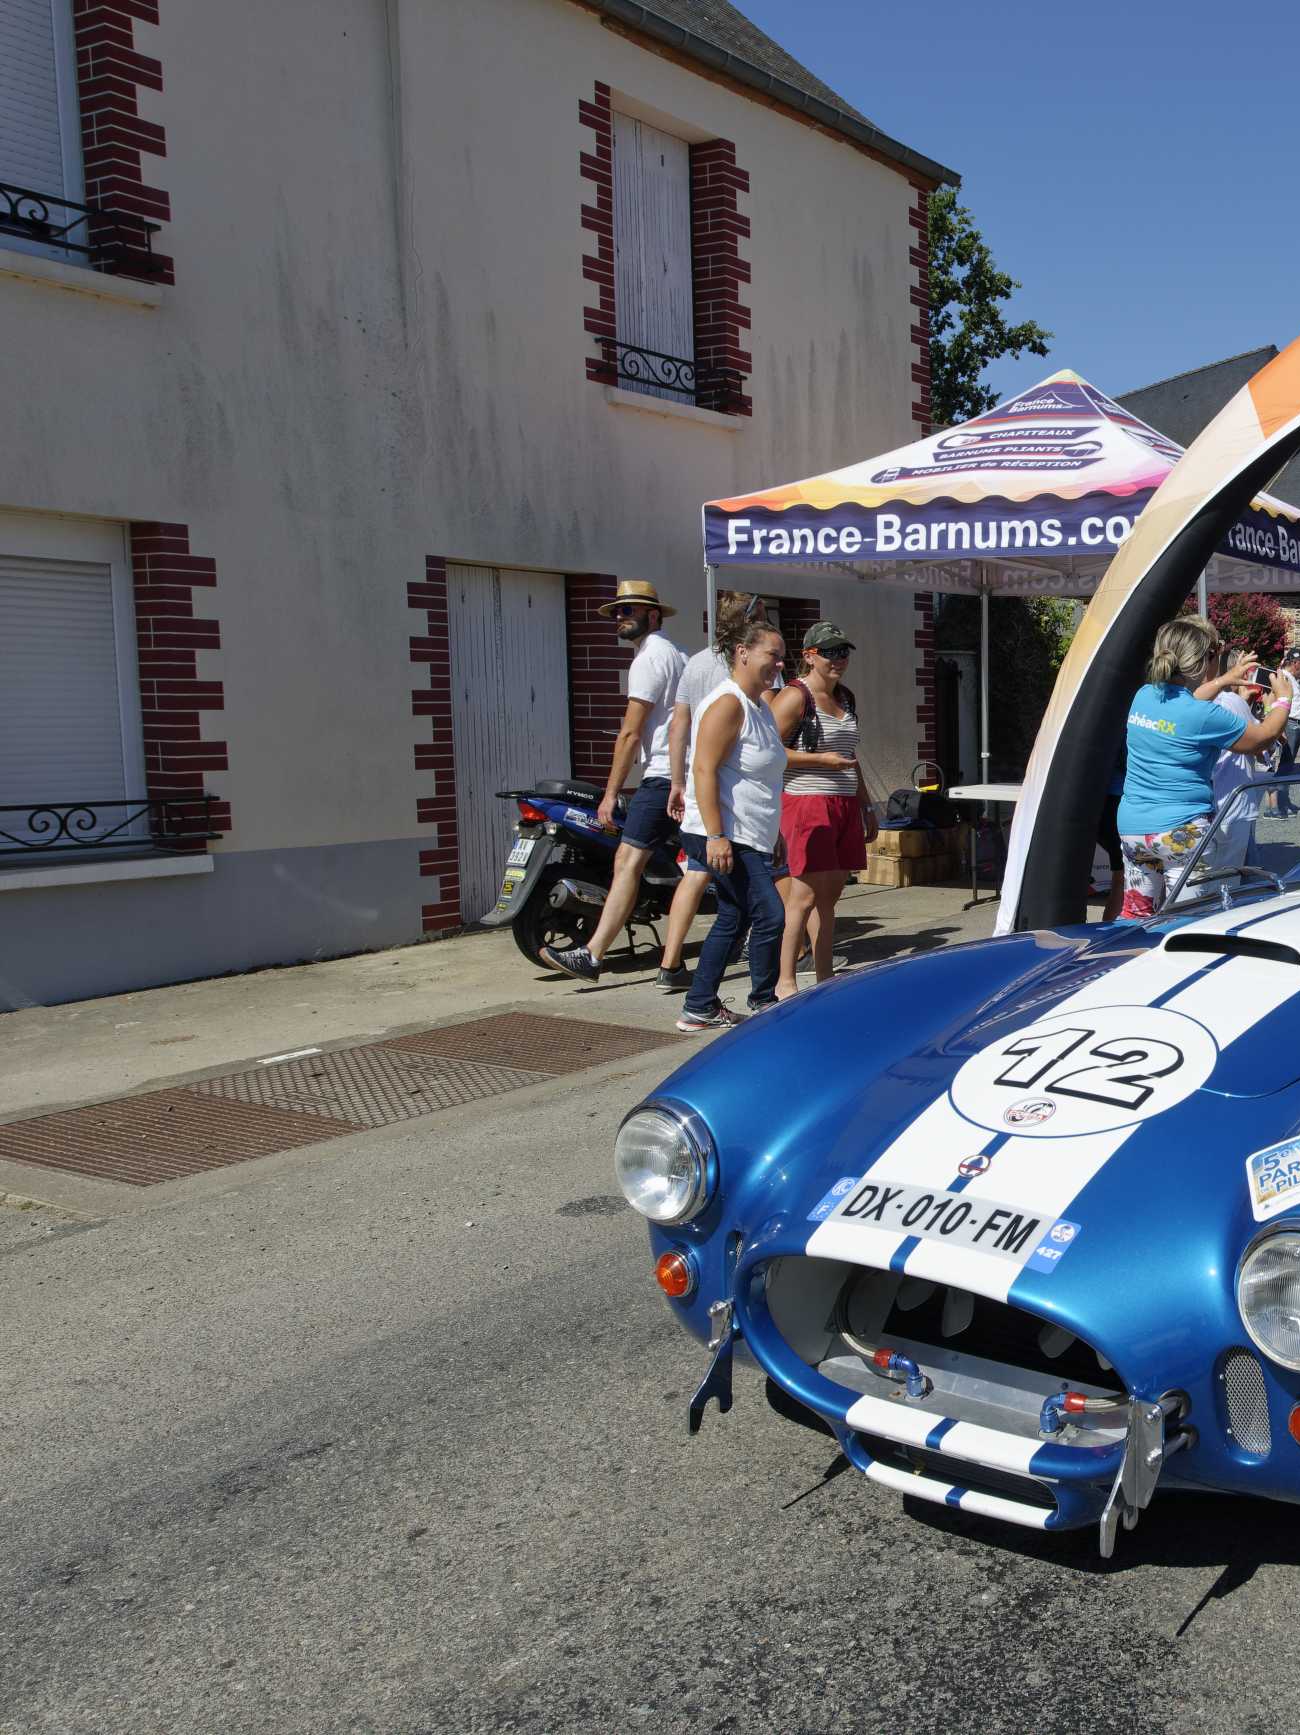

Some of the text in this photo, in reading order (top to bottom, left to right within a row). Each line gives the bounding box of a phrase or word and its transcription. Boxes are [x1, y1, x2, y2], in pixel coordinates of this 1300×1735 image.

[989, 429, 1075, 440] CHAPITEAUX
[939, 445, 1063, 460] BARNUMS PLIANTS
[912, 460, 977, 476] MOBILIER
[1128, 712, 1177, 736] ohéacRX
[993, 1027, 1184, 1111] 12
[1036, 1246, 1063, 1260] 427
